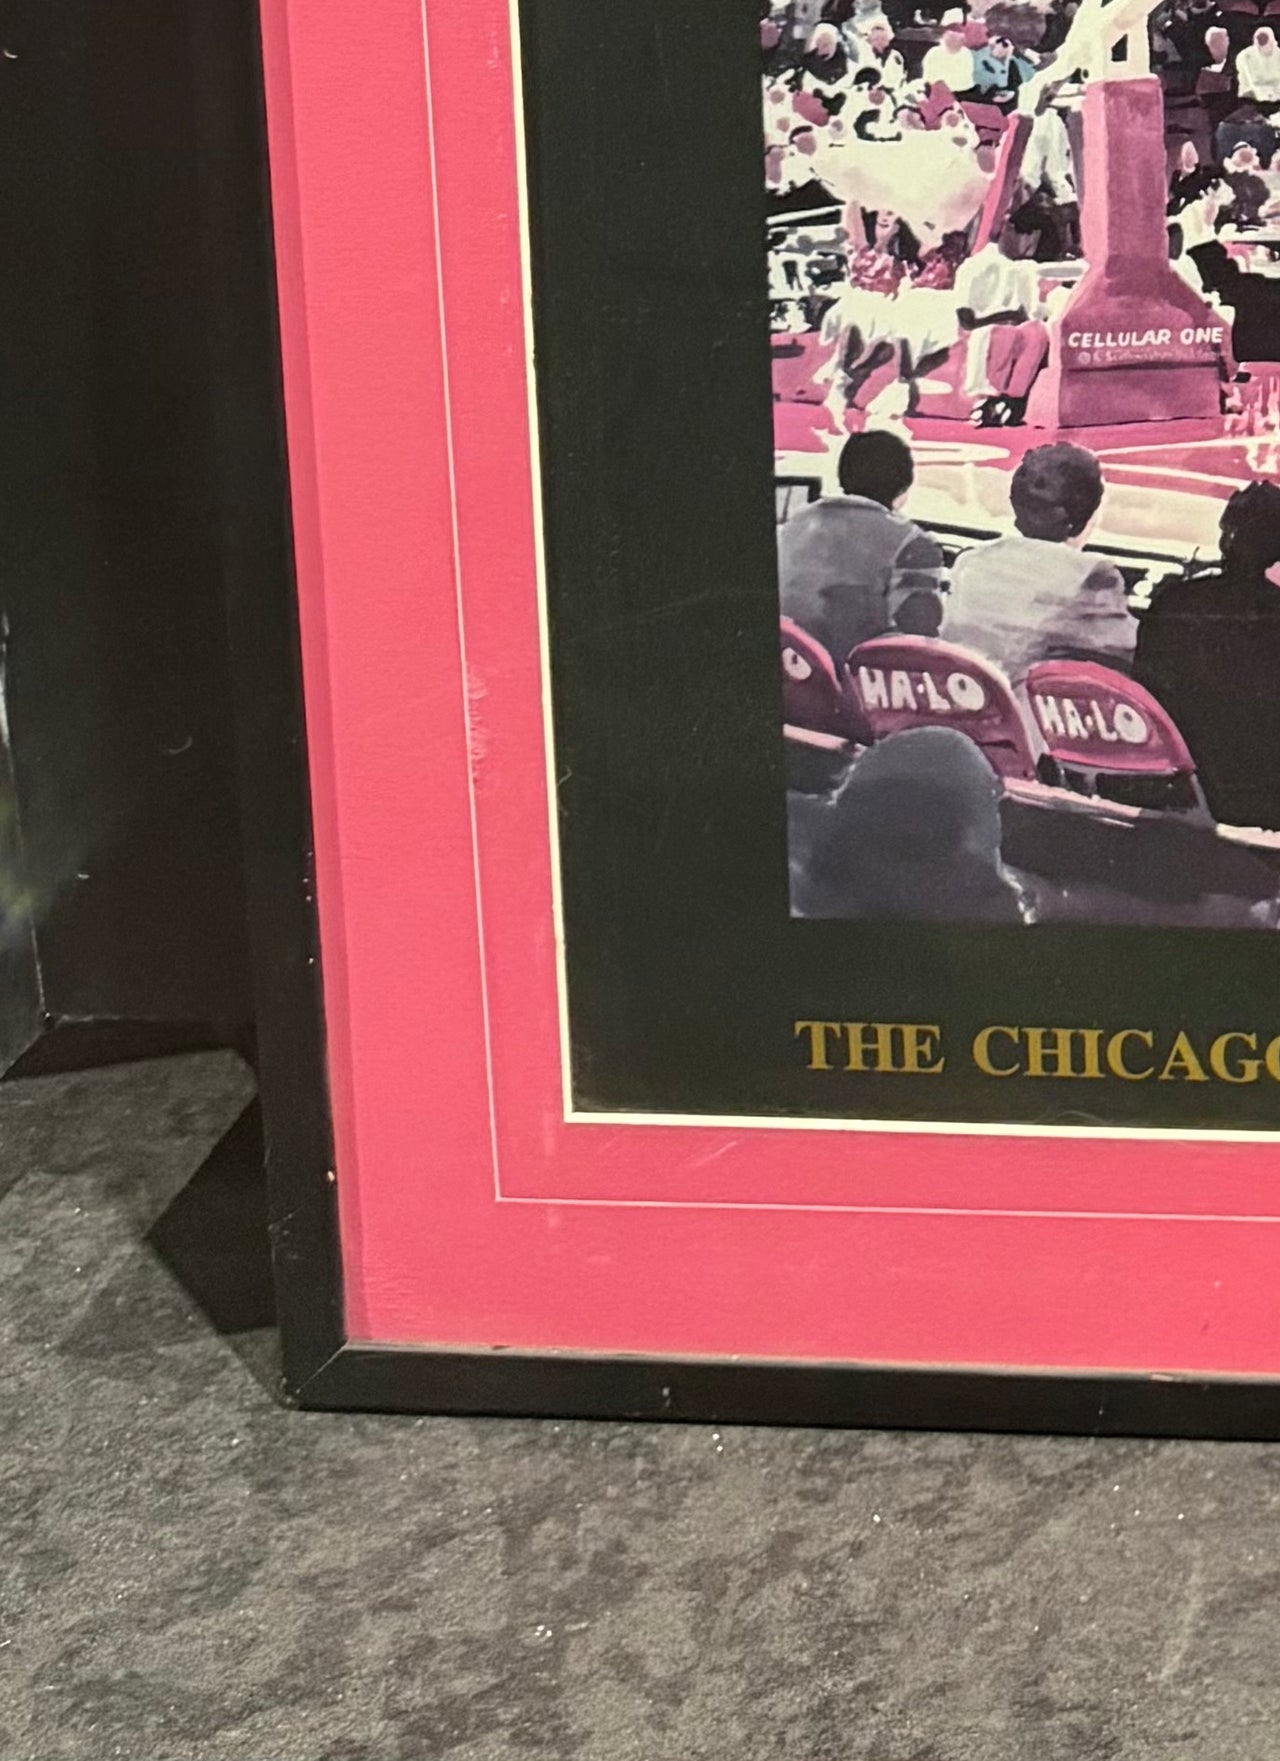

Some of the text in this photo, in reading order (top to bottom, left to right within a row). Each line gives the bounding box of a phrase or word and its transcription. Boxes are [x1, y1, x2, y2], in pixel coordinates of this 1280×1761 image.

[1068, 326, 1223, 348] CELLULAR ONE
[794, 1020, 945, 1075] THE
